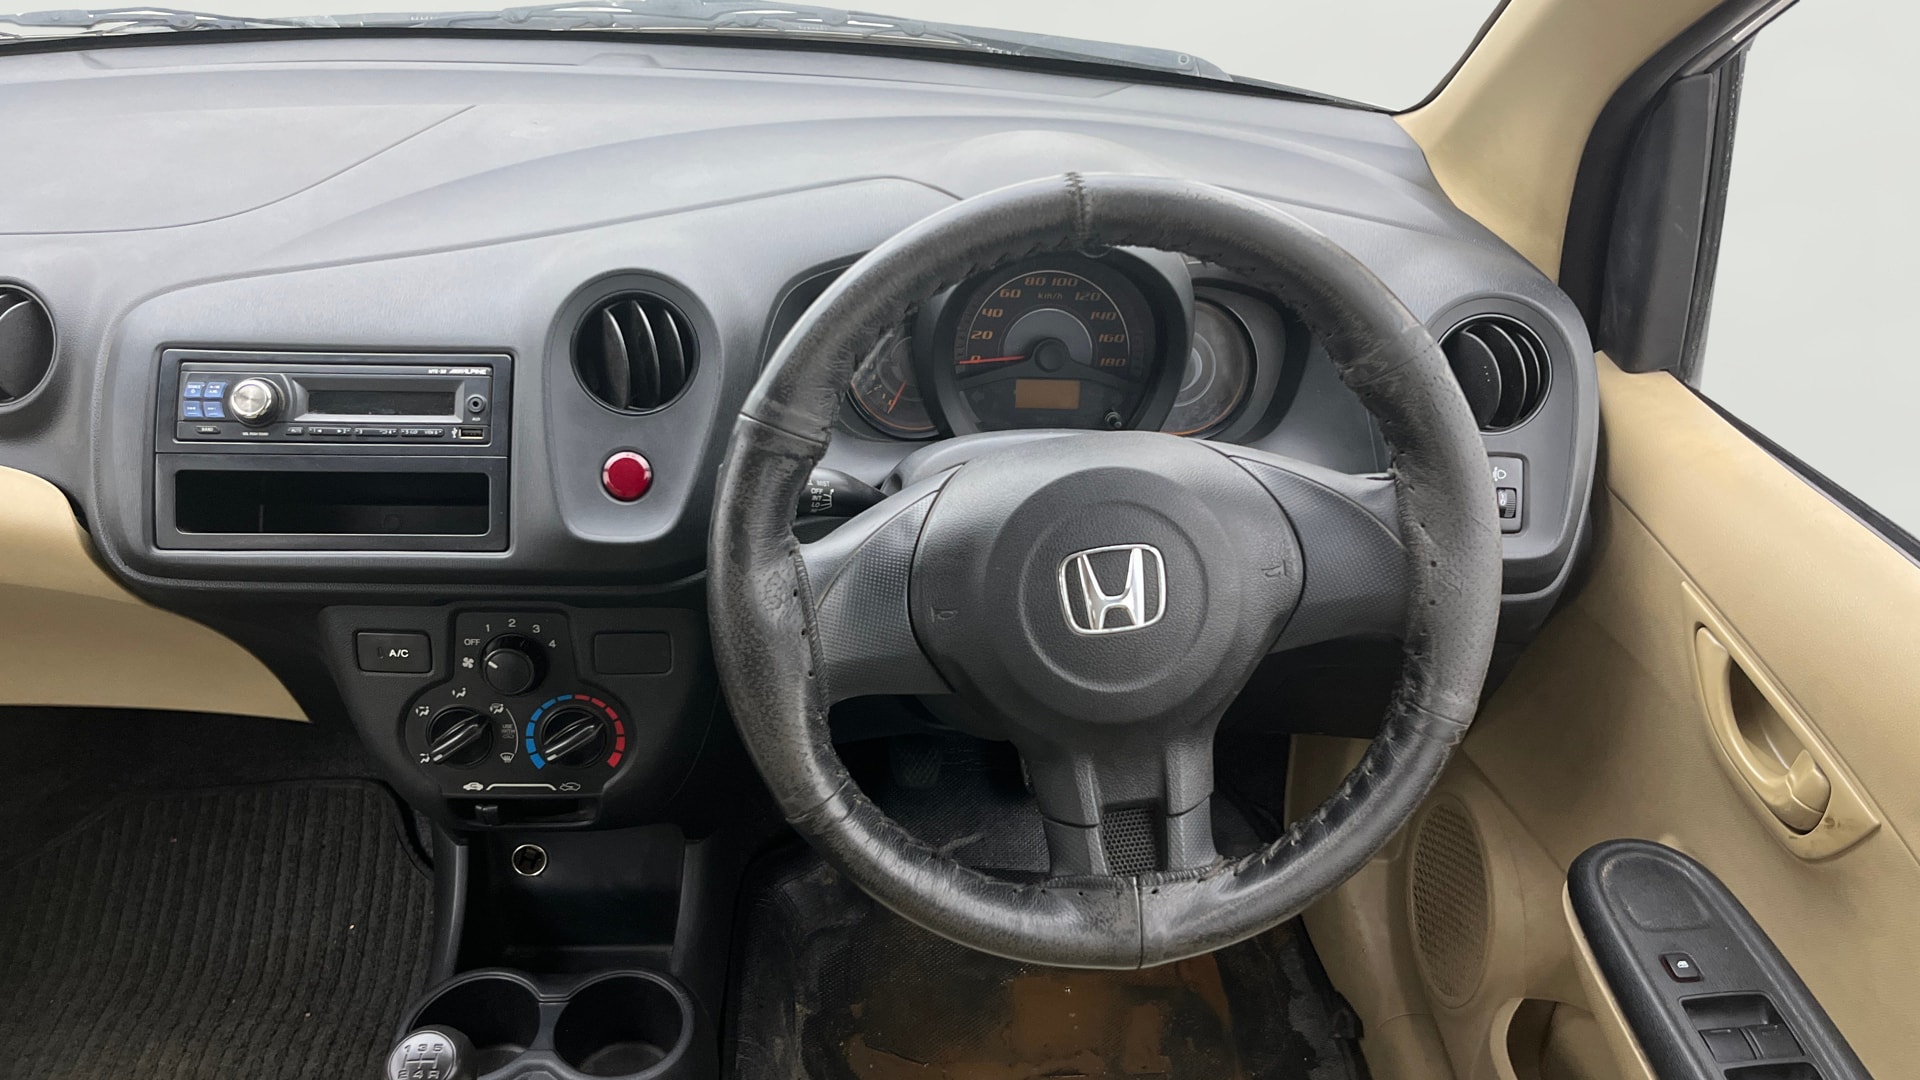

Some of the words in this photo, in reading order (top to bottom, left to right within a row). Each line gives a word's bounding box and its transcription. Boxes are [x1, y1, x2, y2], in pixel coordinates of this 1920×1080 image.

[1024, 277, 1046, 286] 80
[1051, 277, 1078, 287] 100
[1000, 289, 1021, 299] 60
[1038, 291, 1063, 300] km/h
[1074, 291, 1101, 301] 120
[982, 308, 1004, 318] 40
[1090, 311, 1117, 320] 140
[971, 330, 994, 340] 20
[1098, 334, 1125, 343] 160
[1100, 358, 1126, 367] 180
[485, 623, 491, 633] 1
[508, 618, 517, 628] 2
[532, 624, 541, 634] 3
[463, 638, 481, 647] OFF
[548, 639, 557, 649] 4
[389, 649, 409, 658] A/C
[404, 1044, 411, 1053] 1
[417, 1043, 428, 1053] 3
[432, 1043, 444, 1053] 5
[397, 1069, 409, 1080] 2
[412, 1067, 424, 1079] 4
[428, 1069, 440, 1079] R
